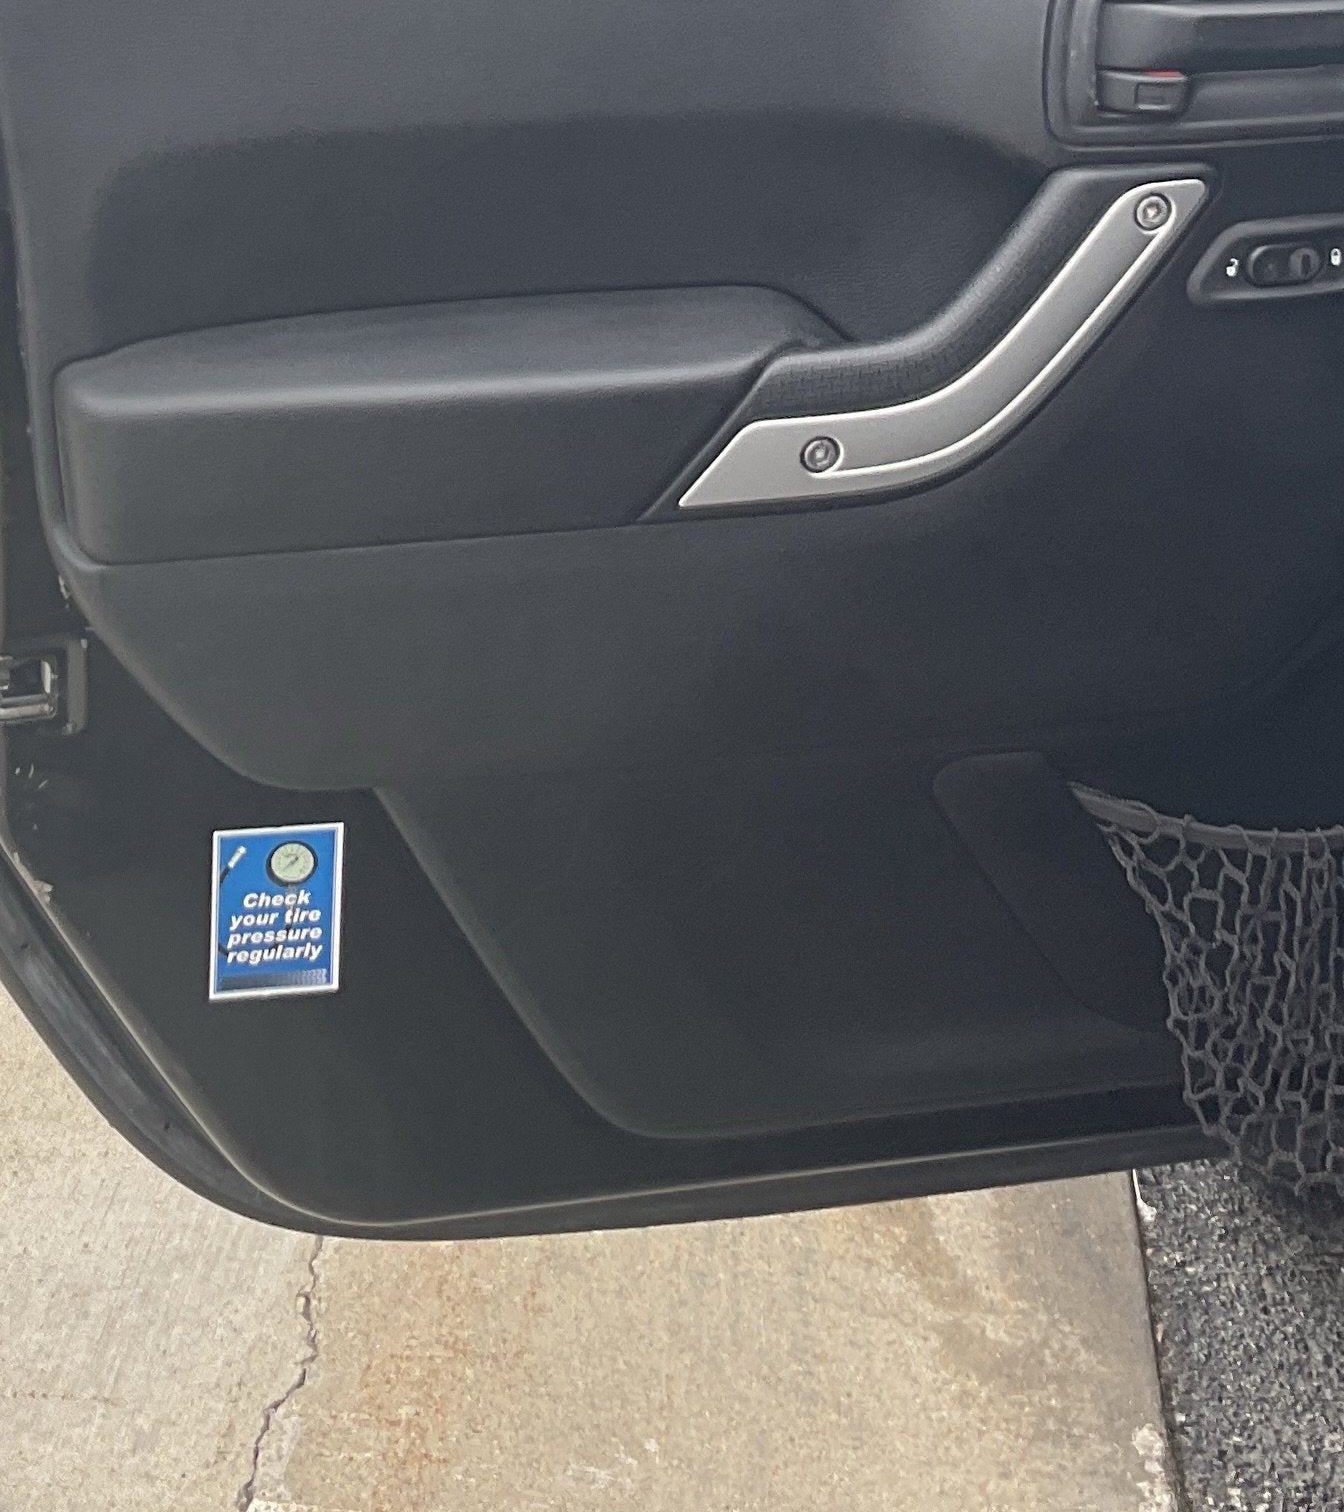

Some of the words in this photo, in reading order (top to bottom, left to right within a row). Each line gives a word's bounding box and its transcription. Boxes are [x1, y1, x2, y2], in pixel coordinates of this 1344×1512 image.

[243, 889, 311, 908] Check
[229, 911, 279, 930] your
[284, 909, 322, 924] tire
[227, 928, 322, 949] pressure
[227, 943, 322, 964] regularly
